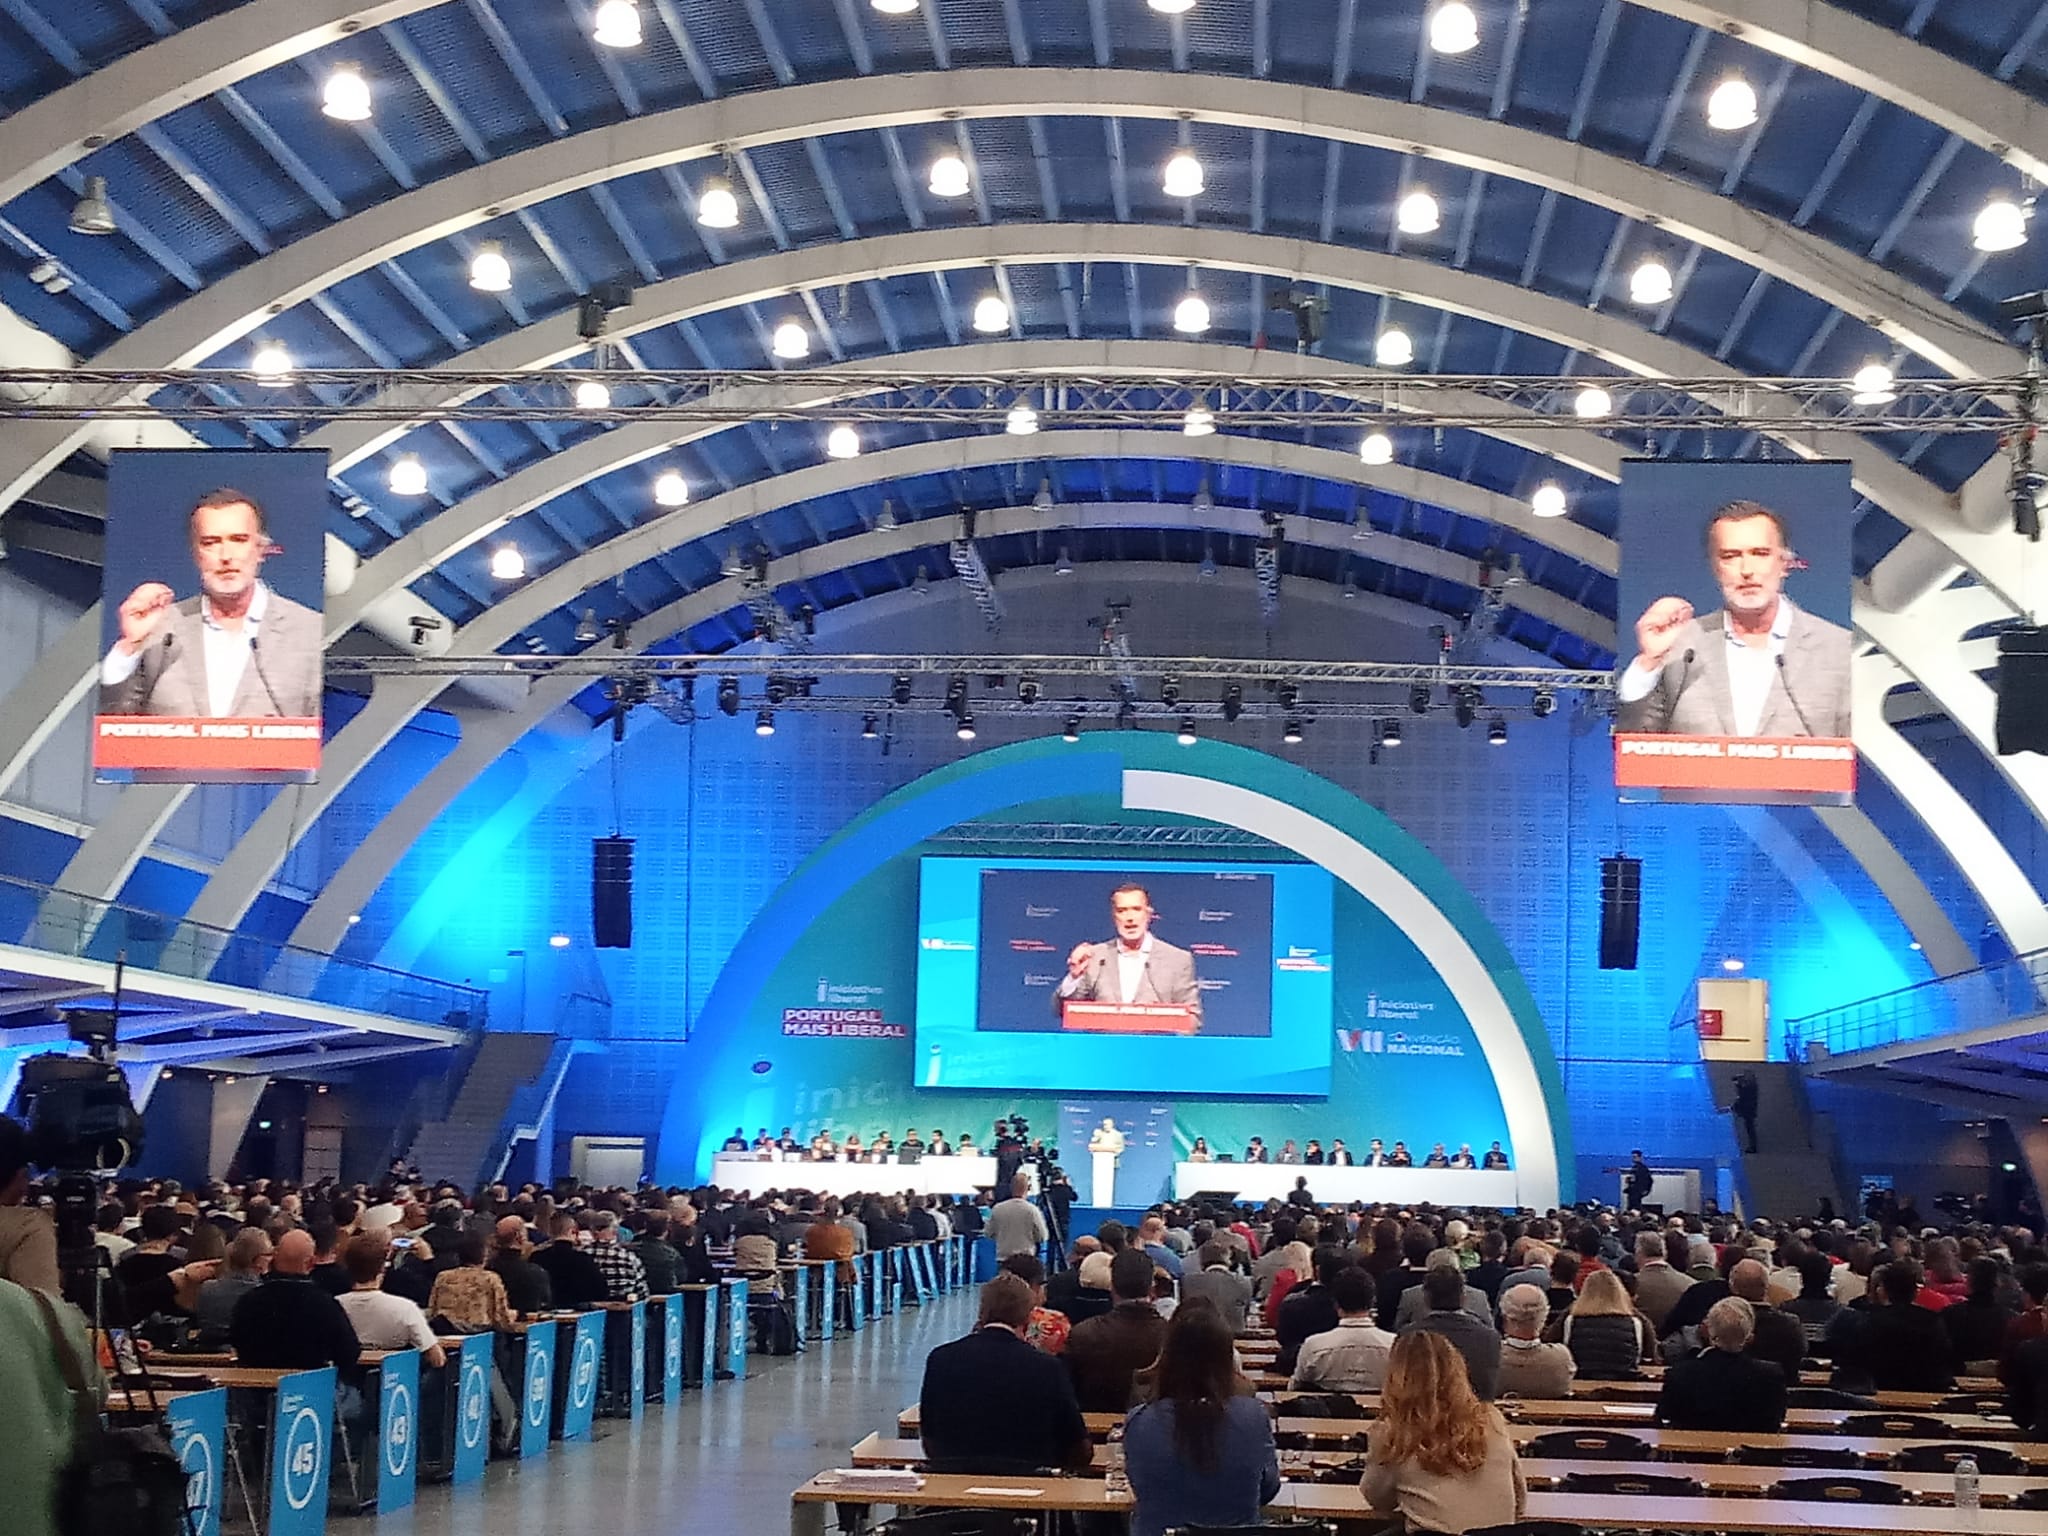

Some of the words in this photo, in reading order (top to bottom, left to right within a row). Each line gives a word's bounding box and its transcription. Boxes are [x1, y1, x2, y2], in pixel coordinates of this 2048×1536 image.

[100, 723, 199, 738] PORTUGAL
[201, 724, 249, 738] MAIS
[1621, 740, 1726, 757] PORTUGAL
[1727, 743, 1778, 759] MAIS
[784, 1009, 882, 1022] PORTUGAL
[784, 1023, 829, 1035] MAIS
[831, 1024, 905, 1037] LIBERAL
[1336, 1029, 1384, 1053] VII
[1386, 1044, 1465, 1057] NACIONAL
[291, 1441, 315, 1476] 45
